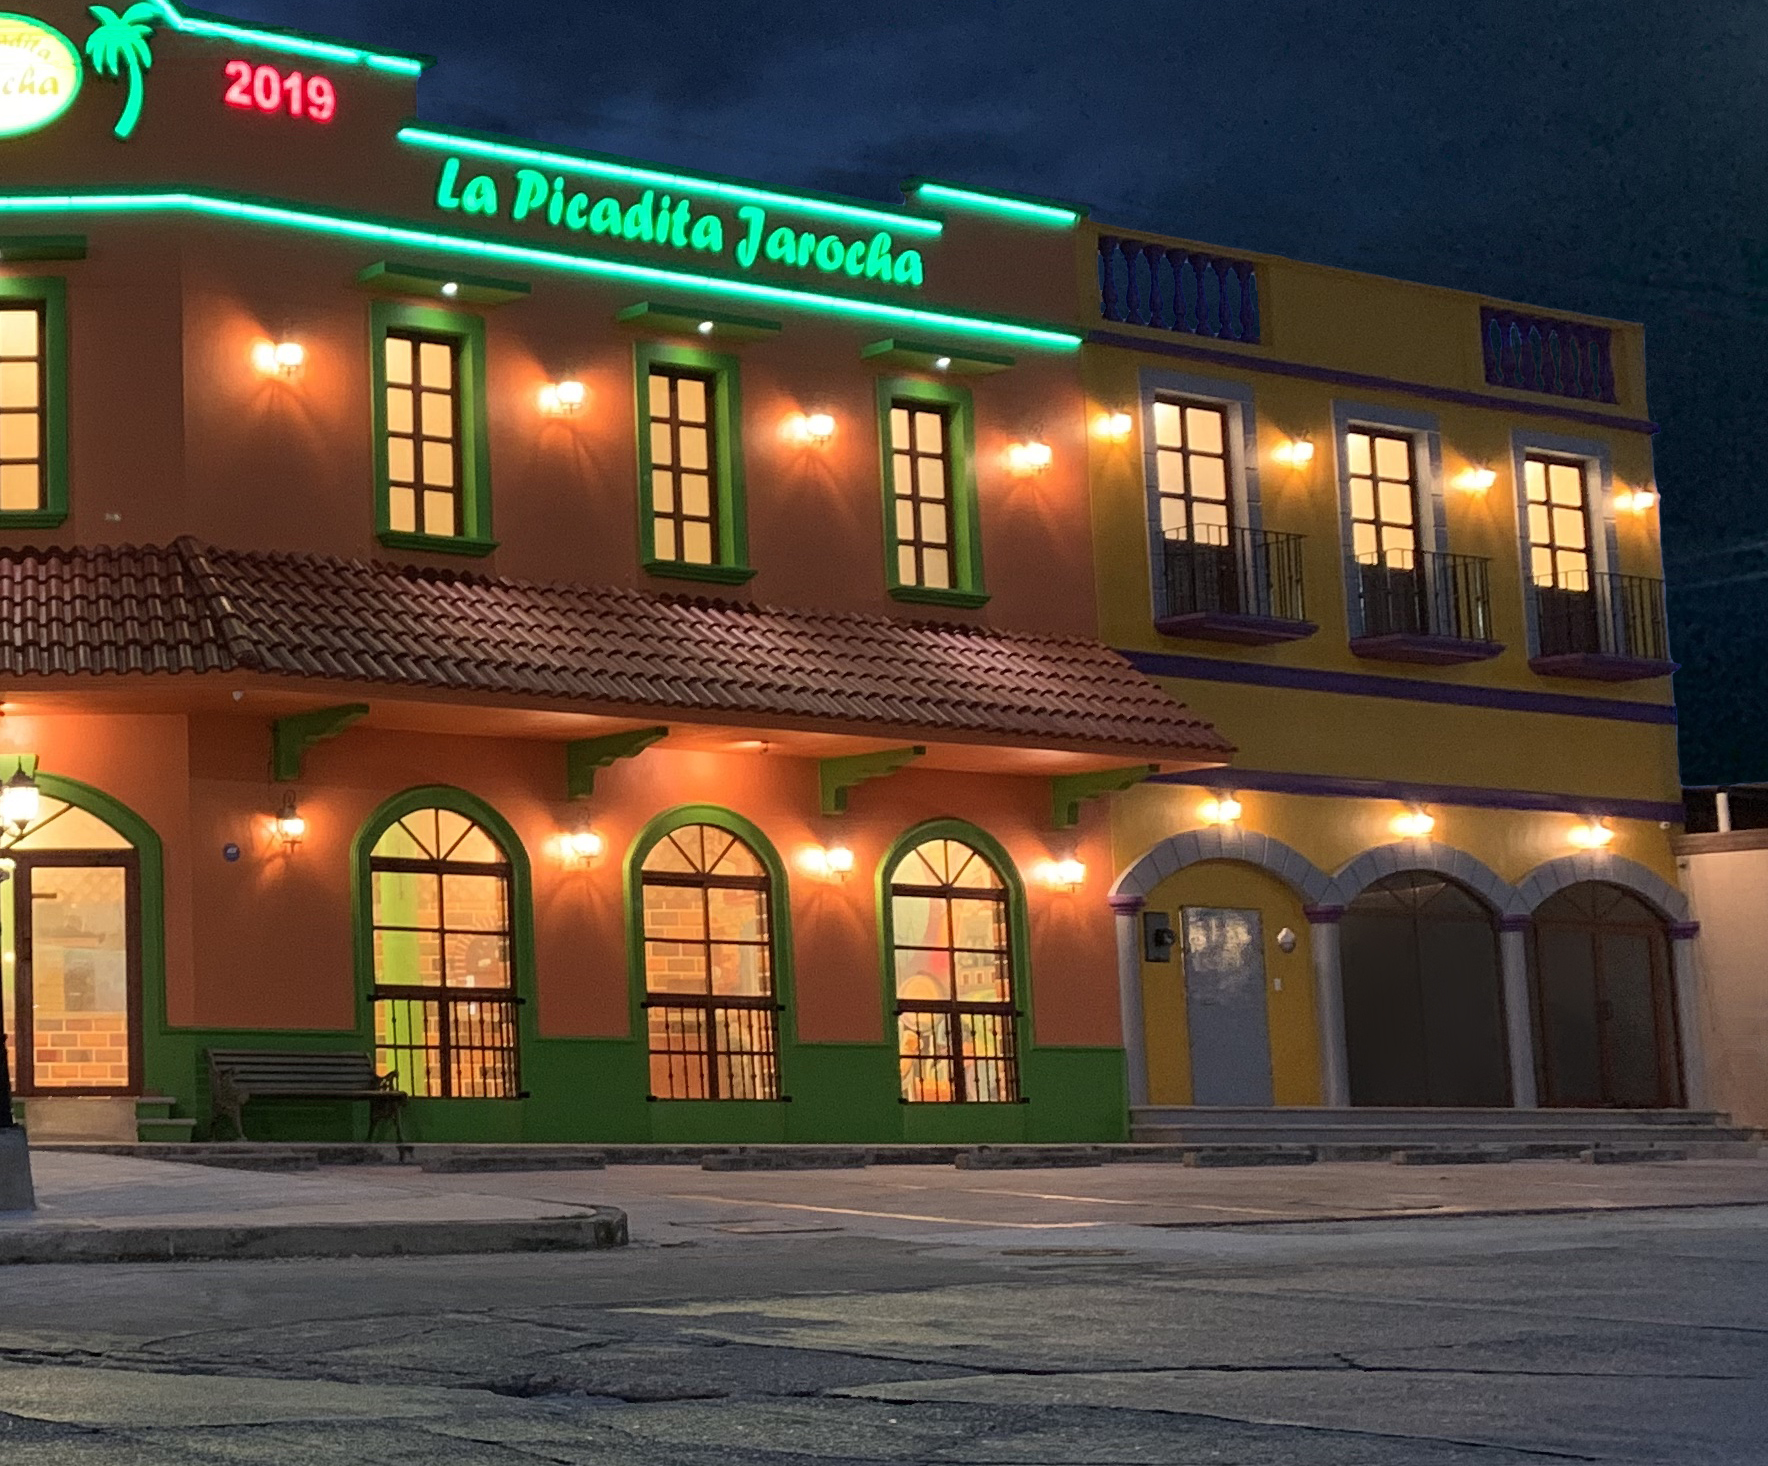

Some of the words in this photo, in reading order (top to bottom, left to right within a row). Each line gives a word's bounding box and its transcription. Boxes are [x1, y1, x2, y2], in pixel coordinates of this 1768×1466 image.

[224, 60, 337, 122] 2019
[437, 157, 498, 215] La
[513, 169, 723, 252] Picadita
[736, 206, 923, 286] Jarocha
